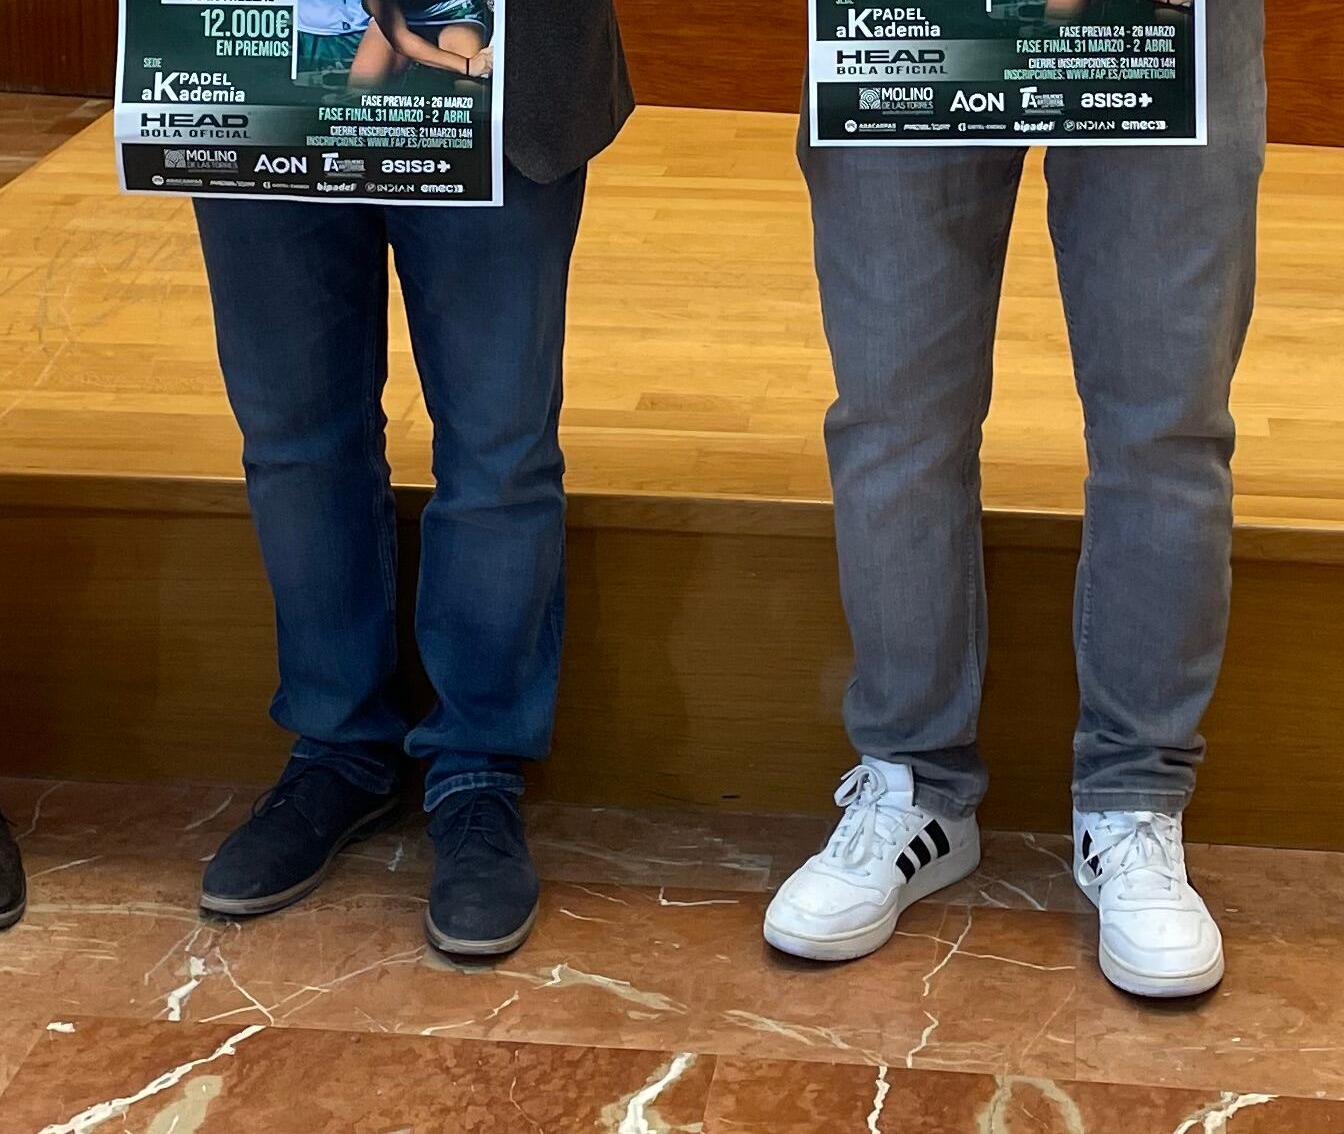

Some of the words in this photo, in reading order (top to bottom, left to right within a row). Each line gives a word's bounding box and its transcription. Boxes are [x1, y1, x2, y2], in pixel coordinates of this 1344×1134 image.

[873, 8, 926, 20] PADEL
[200, 8, 290, 38] 12.000€
[1059, 26, 1081, 38] FASE
[1081, 26, 1112, 38] PREVIA
[1113, 26, 1125, 38] 24
[1132, 26, 1144, 38] 26
[1145, 26, 1175, 38] MARZO
[216, 40, 233, 56] EN
[235, 40, 289, 57] PREMIOS
[1016, 39, 1042, 53] FASE
[1043, 39, 1073, 53] FINAL
[1074, 39, 1087, 53] 31
[1088, 39, 1125, 53] MARZO
[1133, 39, 1141, 53] 2
[1145, 39, 1175, 53] ABRIL
[836, 49, 946, 64] HEAD
[1028, 57, 1056, 69] CIERRE
[1120, 57, 1130, 69] 21
[1131, 57, 1160, 69] MARZO
[836, 66, 878, 75] BOLA
[885, 65, 948, 75] OFICIAL
[179, 72, 232, 86] PADEL
[881, 87, 934, 101] MOLINO
[949, 90, 1005, 112] AON
[361, 95, 383, 108] FASE
[383, 95, 413, 108] PREVIA
[413, 96, 425, 108] 24
[431, 96, 443, 108] 26
[444, 97, 474, 109] MARZO
[140, 112, 249, 128] HEAD
[318, 107, 344, 121] FASE
[345, 108, 374, 122] FINAL
[375, 109, 387, 122] 31
[389, 109, 424, 123] MARZO
[432, 110, 440, 123] 2
[442, 110, 473, 124] ABRIL
[140, 129, 183, 138] BOLA
[189, 129, 252, 139] OFICIAL
[419, 127, 429, 137] 21
[430, 127, 457, 138] MARZO
[186, 149, 238, 162] MOLINO
[254, 153, 307, 174] AON
